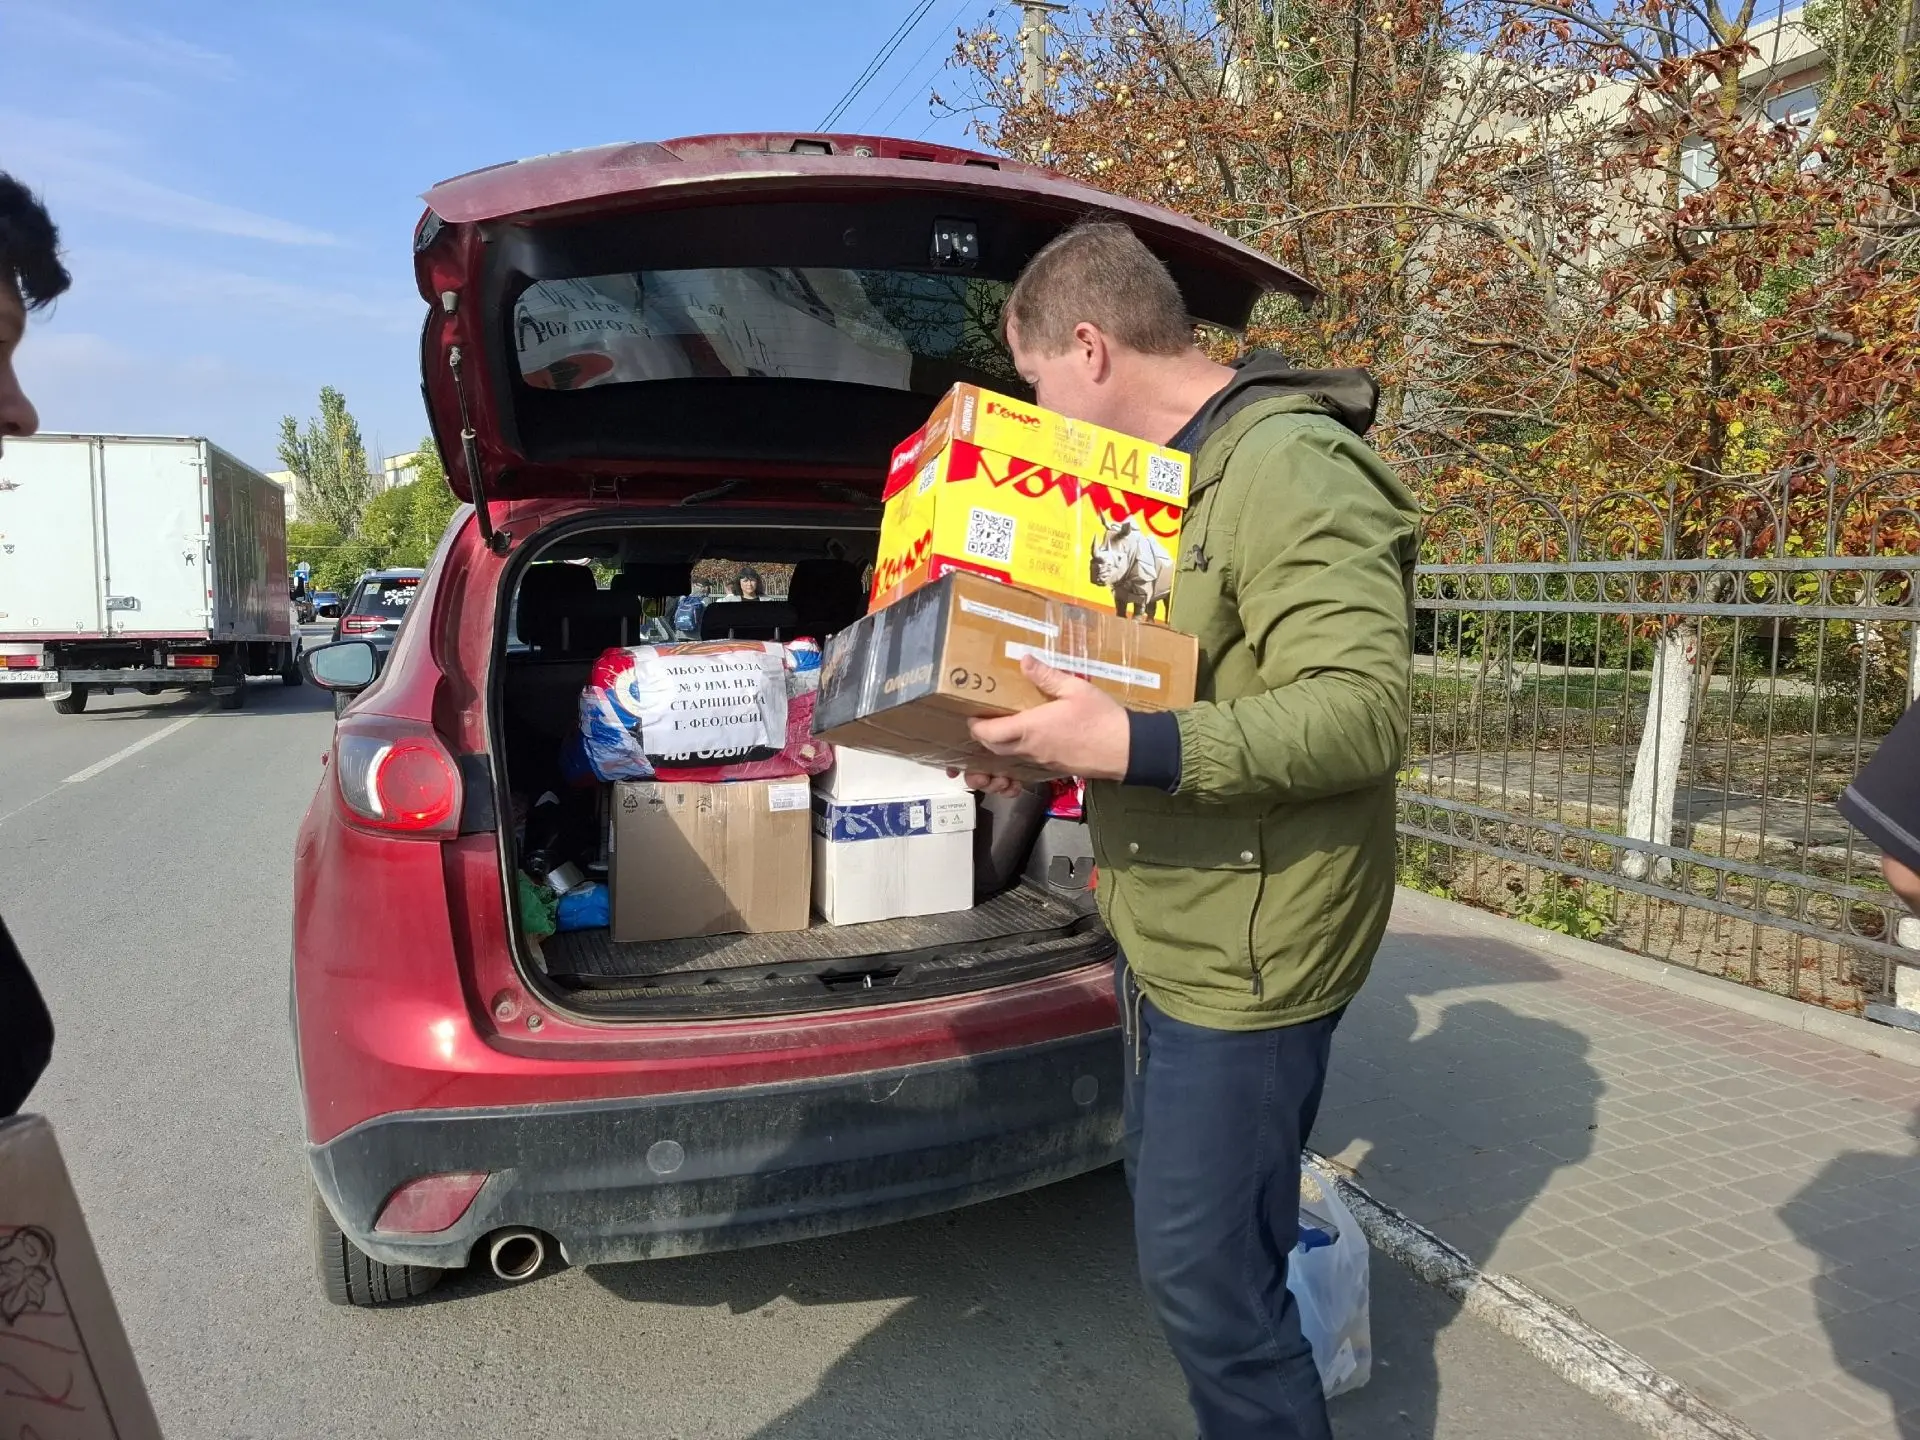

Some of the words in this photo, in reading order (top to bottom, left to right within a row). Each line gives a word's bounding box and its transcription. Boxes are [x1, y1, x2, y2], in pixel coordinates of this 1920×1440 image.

[1099, 440, 1139, 486] A4
[666, 664, 707, 676] МБОУ
[710, 663, 762, 673] ШКОЛА
[694, 682, 701, 691] 9
